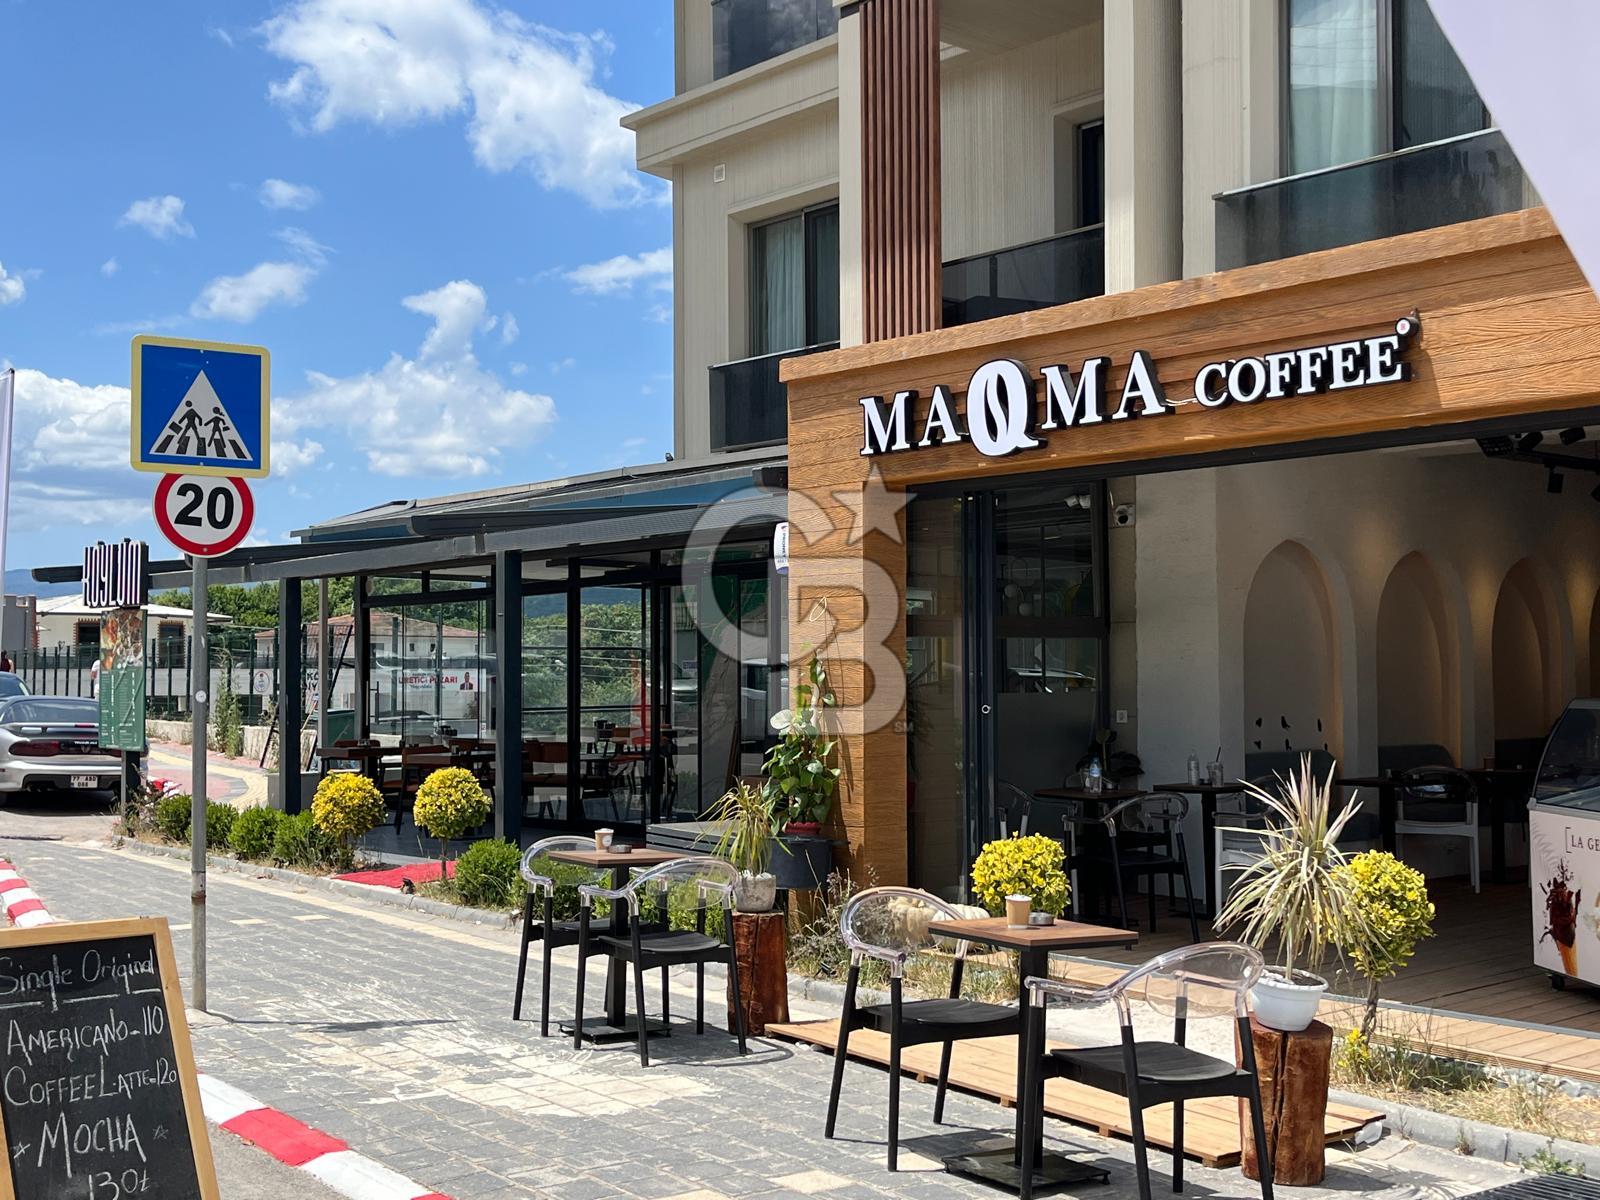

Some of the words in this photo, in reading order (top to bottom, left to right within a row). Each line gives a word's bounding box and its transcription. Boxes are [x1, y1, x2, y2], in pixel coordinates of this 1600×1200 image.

[860, 350, 1168, 457] MAQMA
[1194, 334, 1404, 408] COFFEE
[174, 483, 234, 530] 20
[1572, 834, 1584, 849] LA
[0, 954, 73, 1012] Single
[82, 949, 155, 994] Original
[38, 1111, 147, 1179] MOCHA
